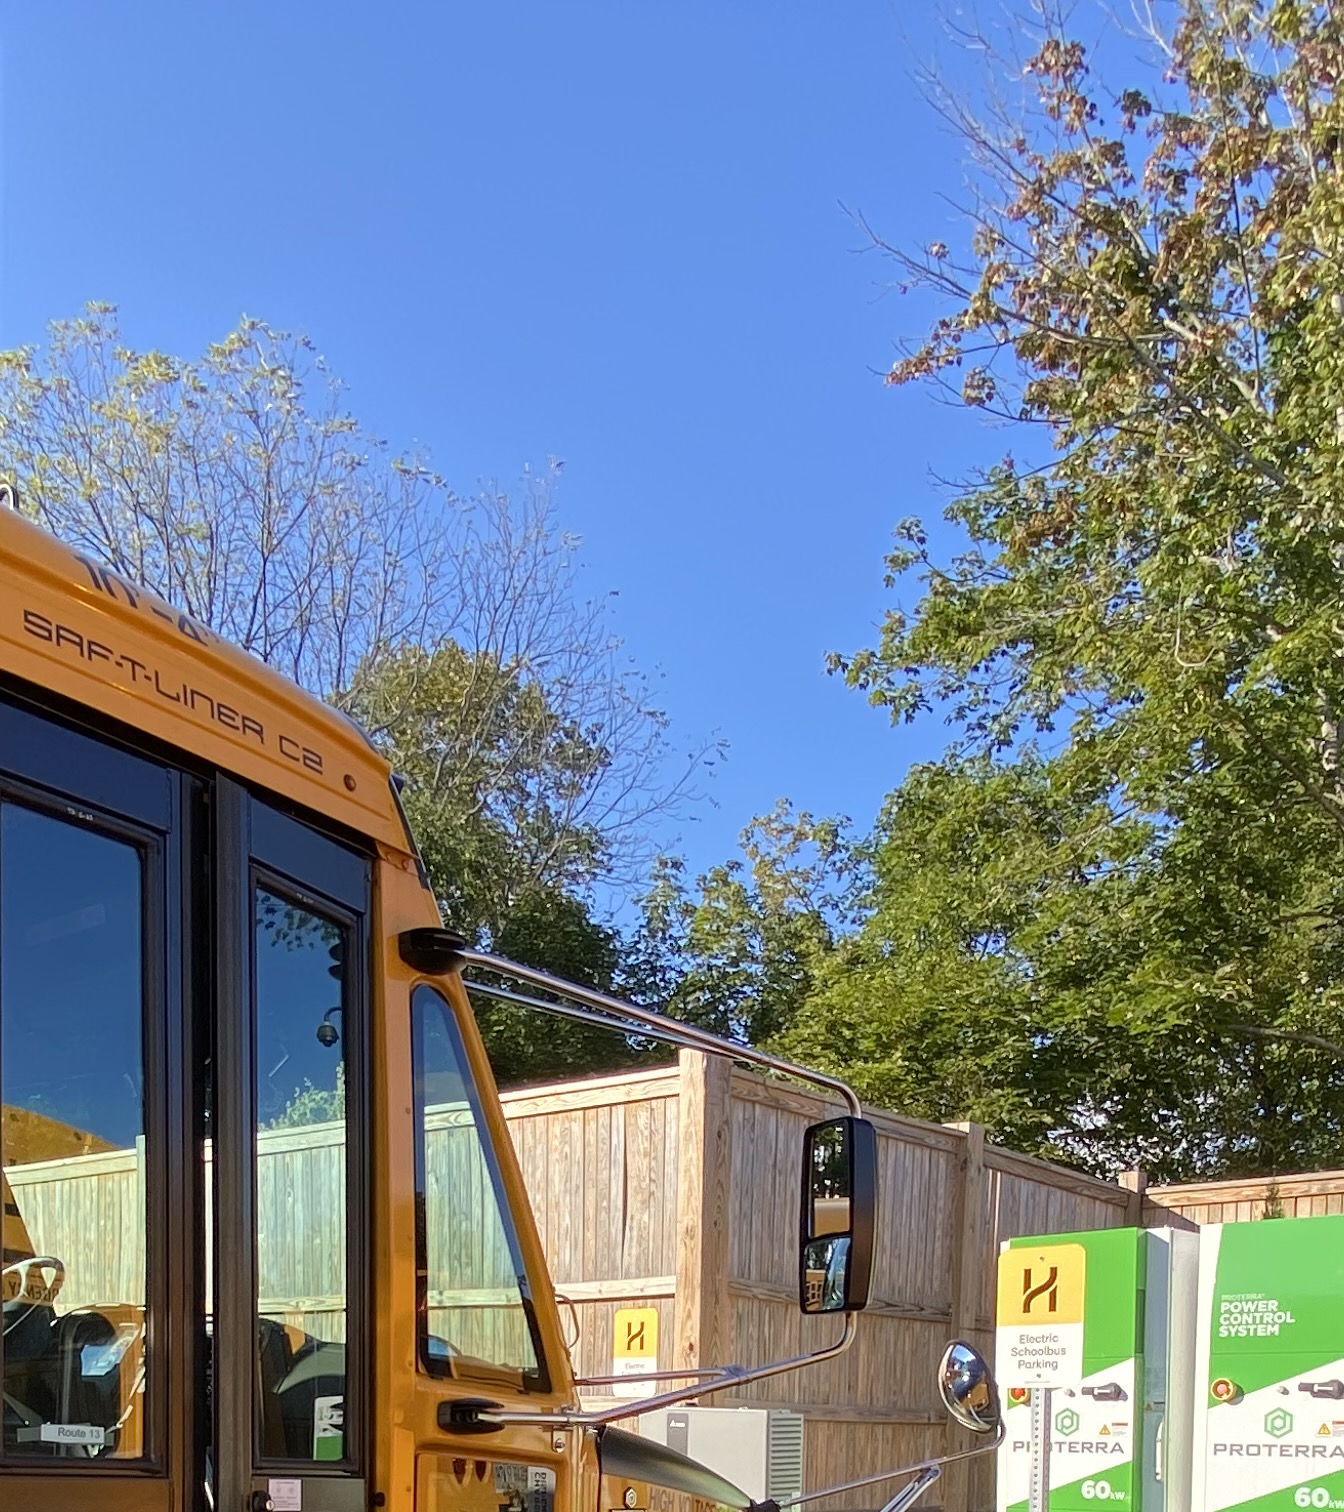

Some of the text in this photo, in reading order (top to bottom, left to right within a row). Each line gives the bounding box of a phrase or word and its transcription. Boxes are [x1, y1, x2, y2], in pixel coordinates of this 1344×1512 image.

[22, 608, 324, 775] SAF-T-LINER C2
[1220, 1300, 1279, 1313] POWER
[1219, 1311, 1296, 1325] CONTROL
[1218, 1324, 1280, 1337] SYSTEM
[1019, 1333, 1059, 1344] Electric
[1010, 1346, 1067, 1357] Schoolbus
[1017, 1359, 1058, 1371] Parking
[57, 1427, 101, 1439] Route 13
[1013, 1441, 1125, 1454] PTERRA
